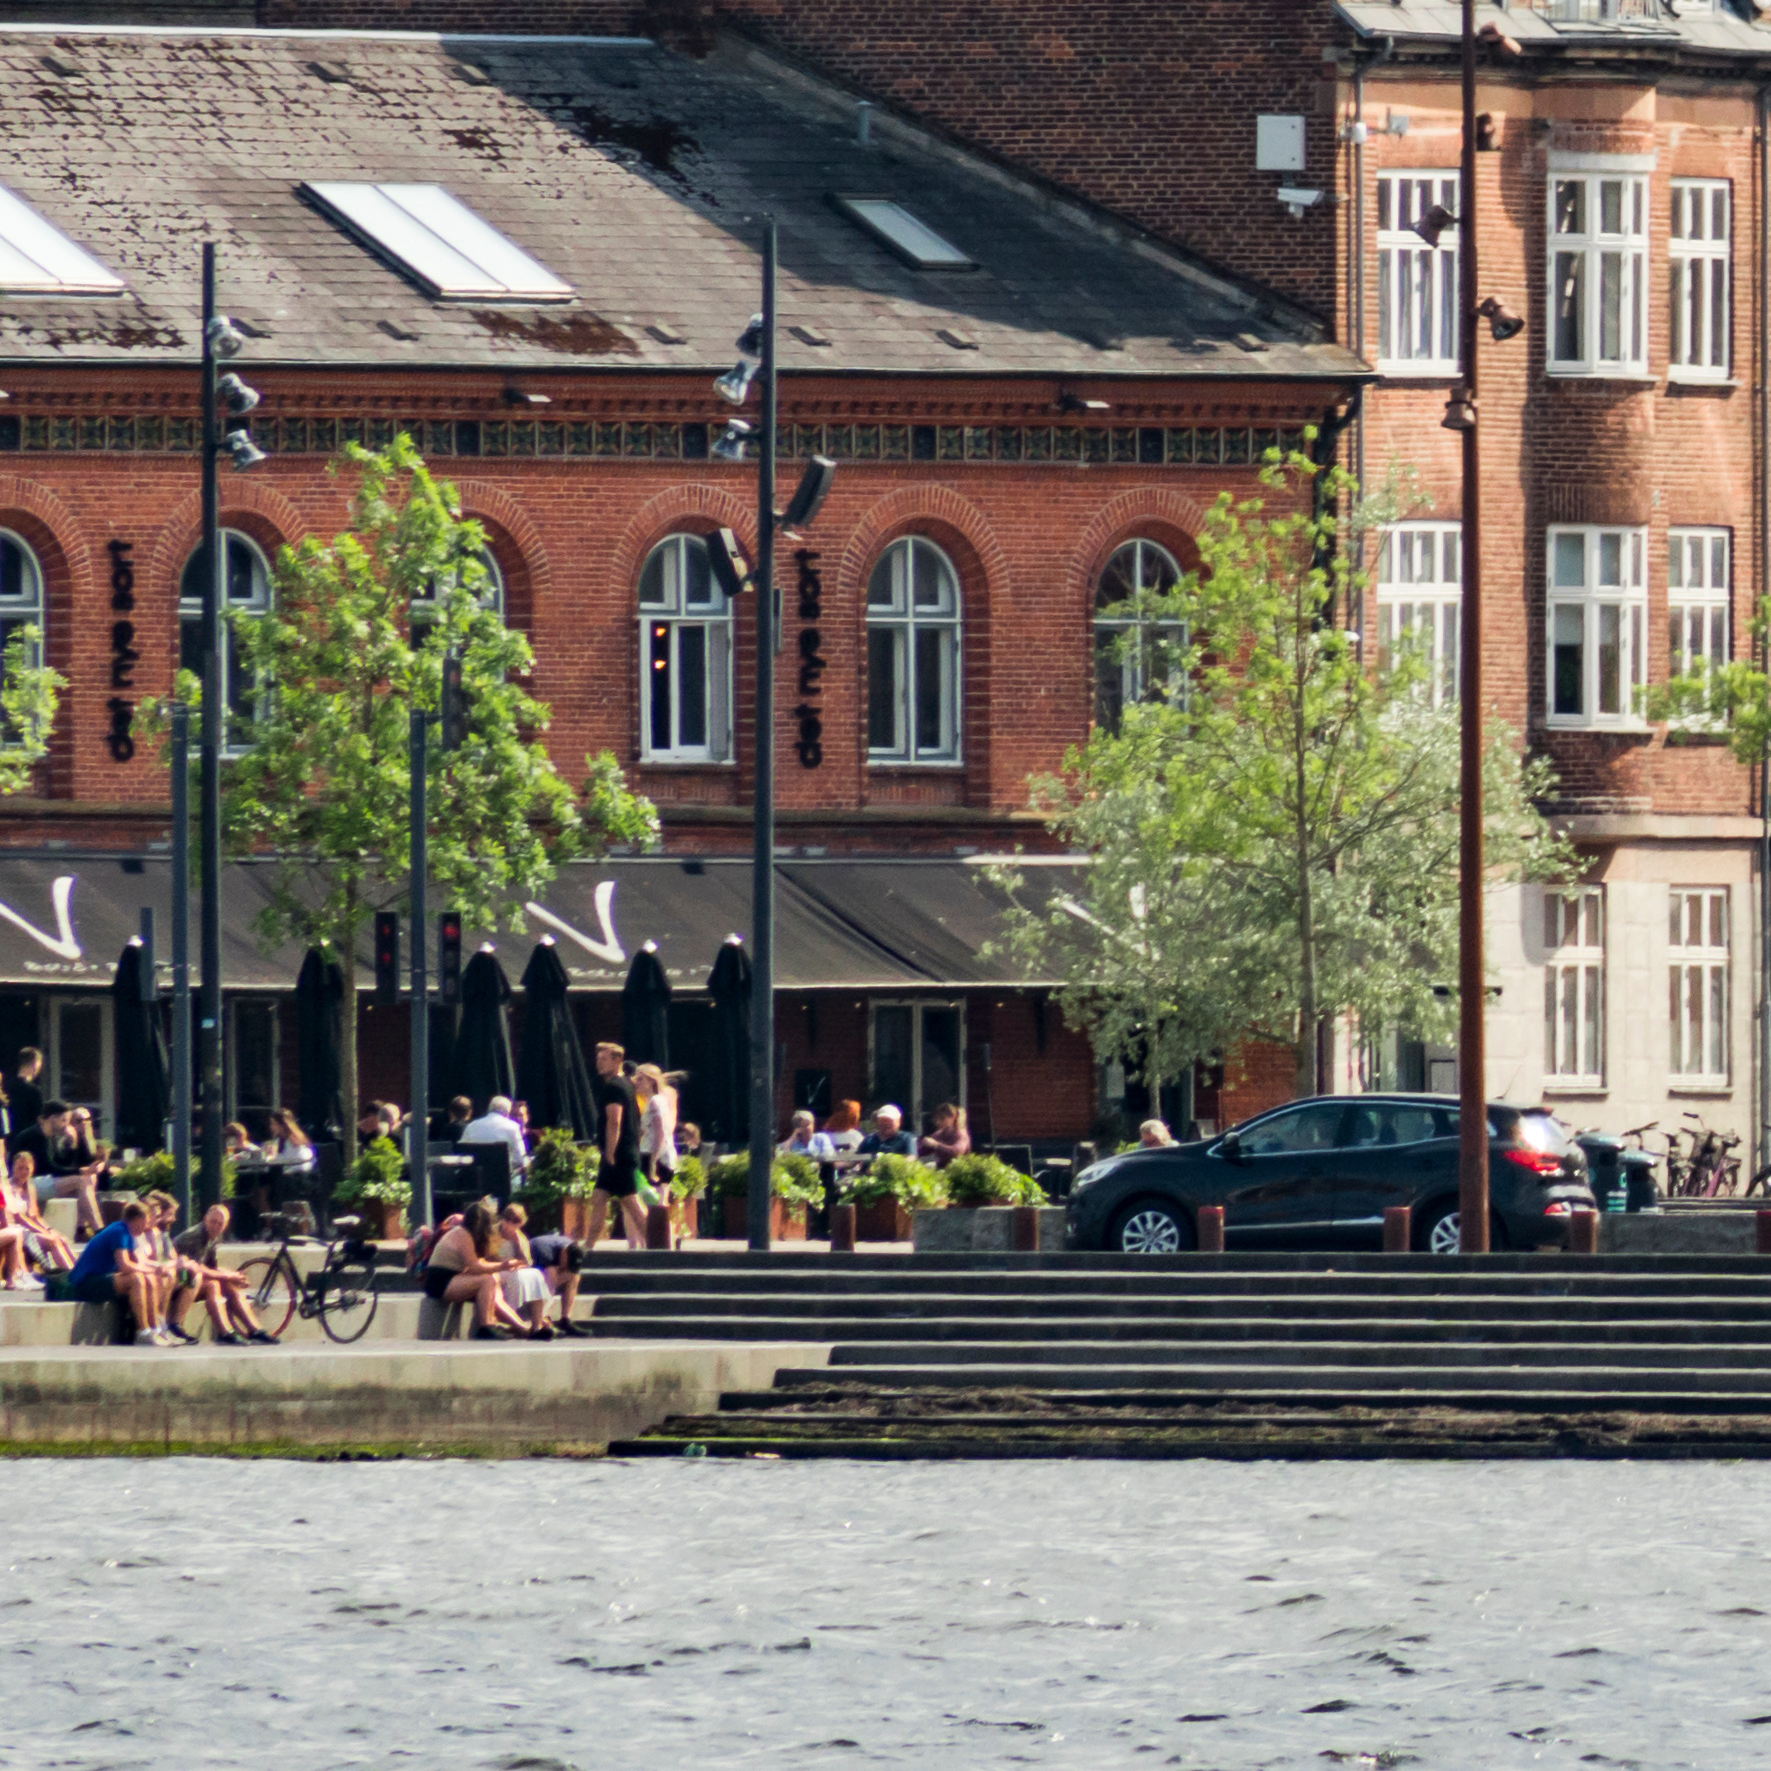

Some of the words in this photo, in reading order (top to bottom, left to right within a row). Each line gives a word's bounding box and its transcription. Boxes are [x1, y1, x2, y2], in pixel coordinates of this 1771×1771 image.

[106, 538, 135, 611] sort
[795, 547, 823, 620] sort
[793, 703, 823, 770] det
